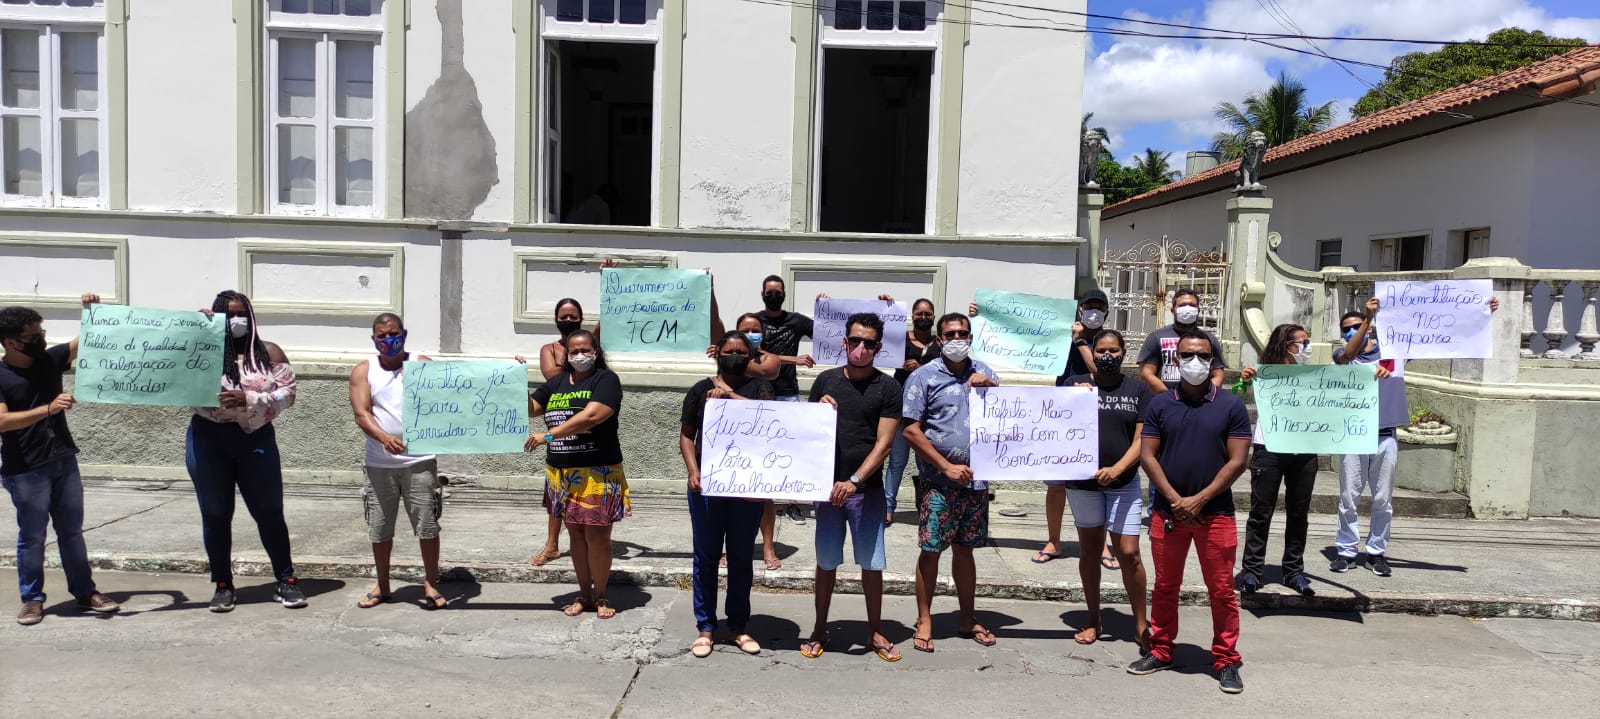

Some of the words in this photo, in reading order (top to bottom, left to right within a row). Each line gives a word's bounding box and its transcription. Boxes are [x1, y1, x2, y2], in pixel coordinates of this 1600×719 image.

[1379, 284, 1396, 309] A
[681, 299, 696, 312] do
[81, 304, 120, 327] Nunca
[626, 319, 678, 344] TCM
[78, 357, 92, 371] a
[186, 354, 212, 371] do
[550, 390, 592, 402] BELMONTE
[1105, 395, 1119, 403] DO
[1120, 395, 1139, 405] MAR
[471, 401, 500, 416] os
[546, 400, 570, 410] BAHIA
[704, 400, 796, 449] Justiça
[1265, 413, 1279, 434] A
